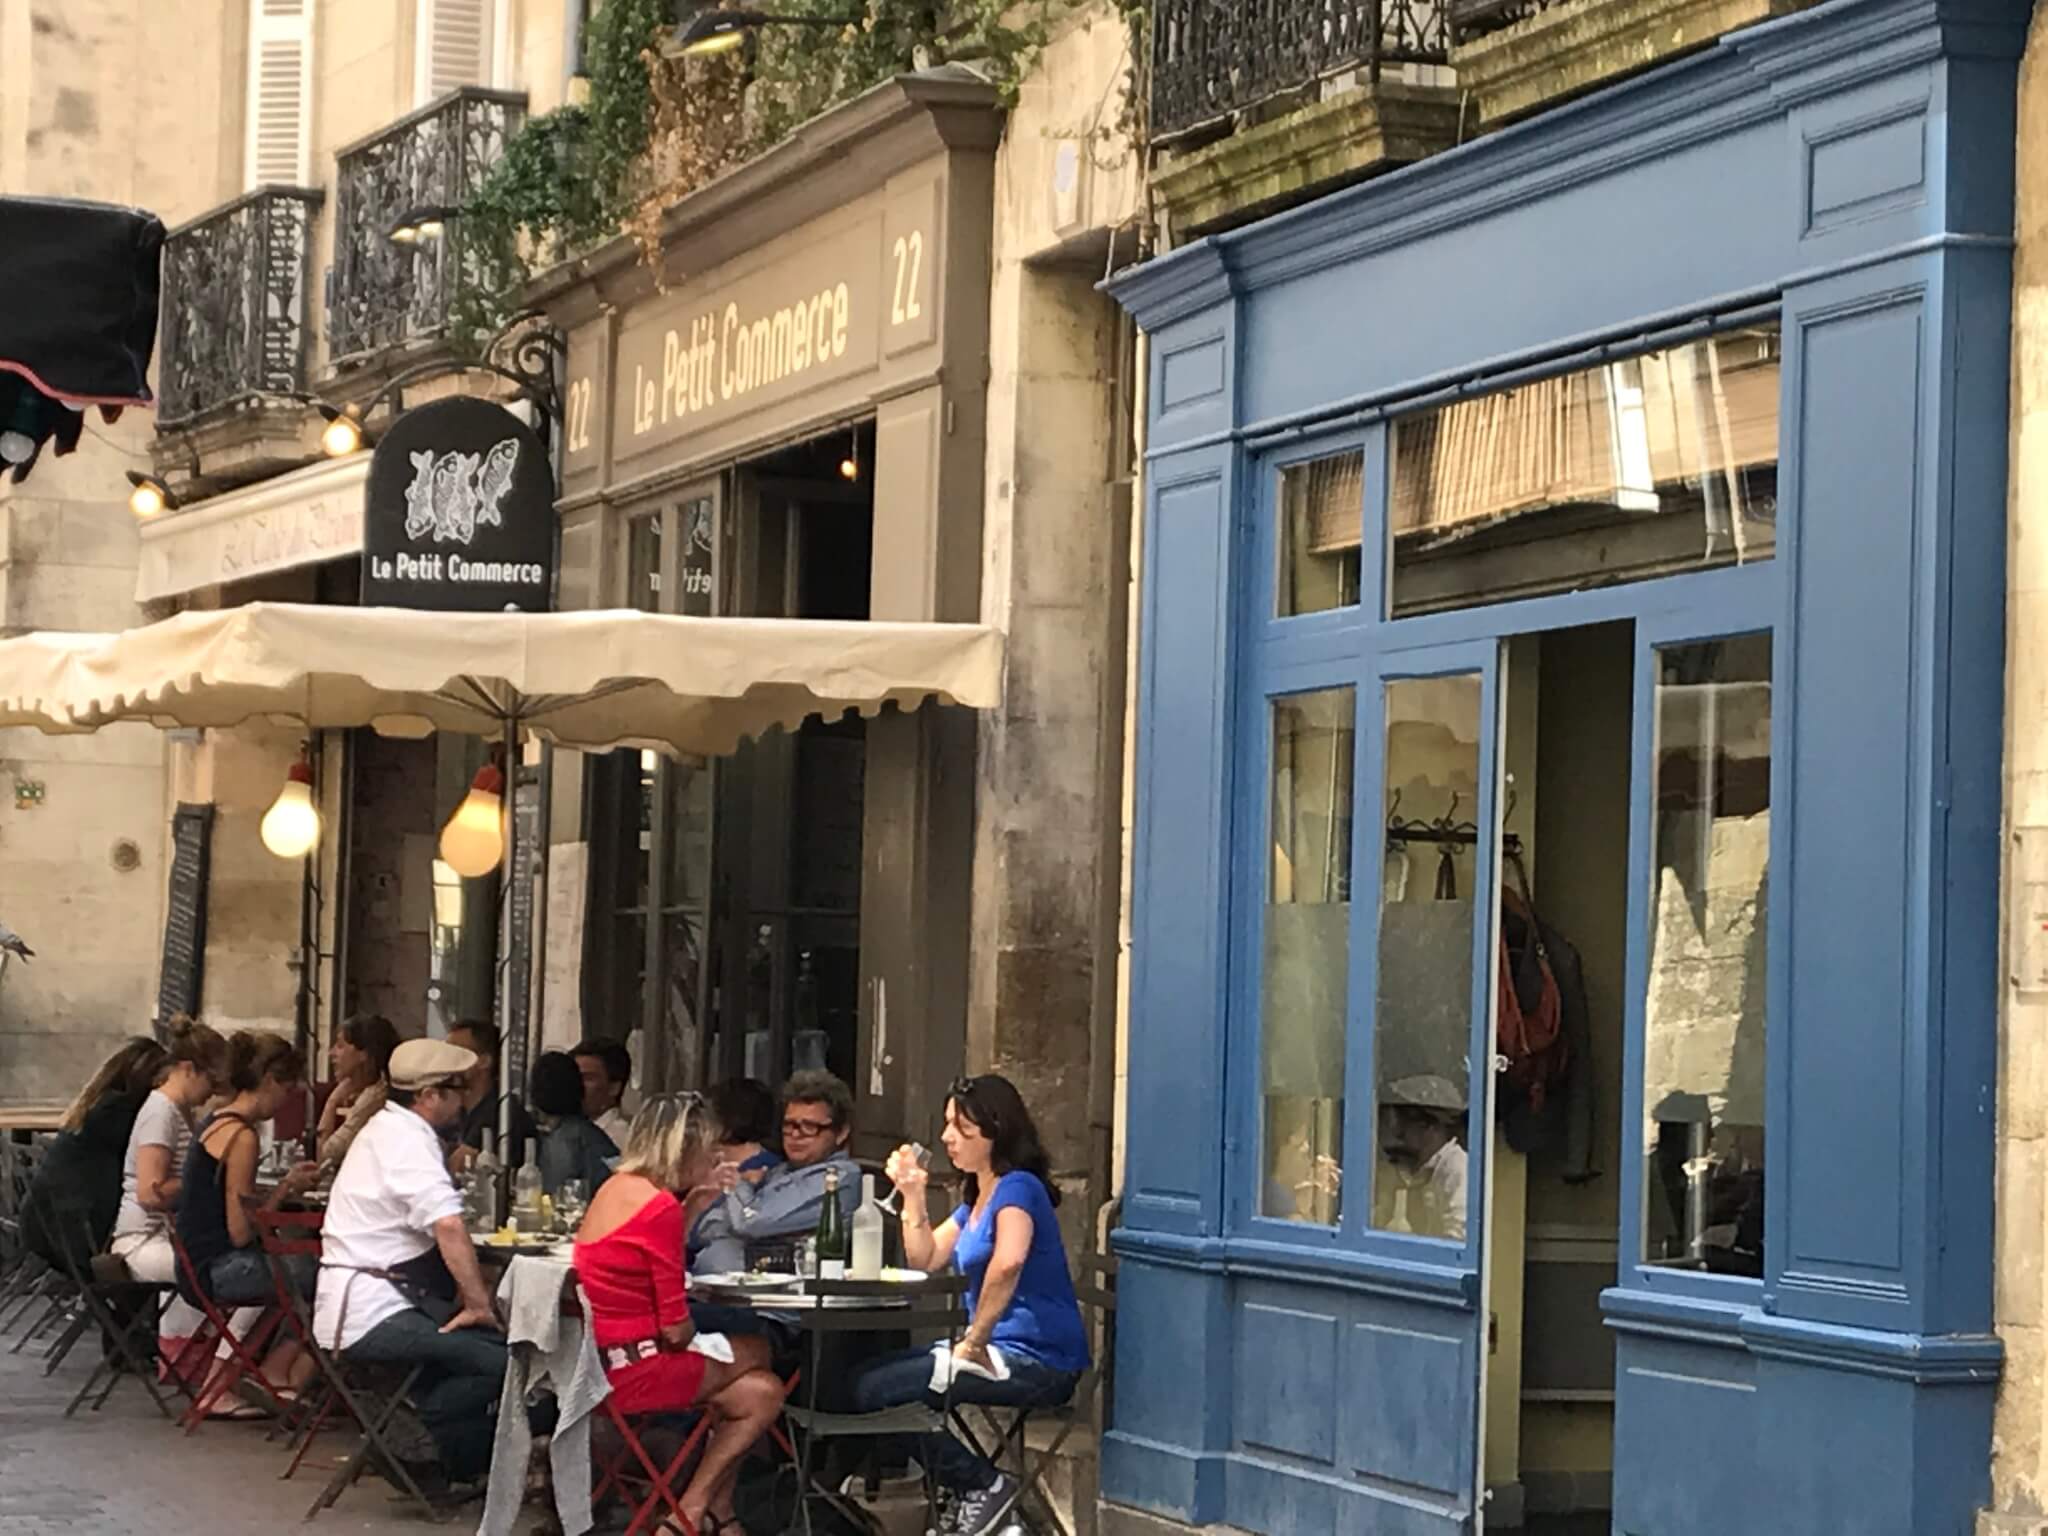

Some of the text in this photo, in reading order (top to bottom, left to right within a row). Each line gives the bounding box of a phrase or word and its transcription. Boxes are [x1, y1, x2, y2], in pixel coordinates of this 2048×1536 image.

[891, 230, 922, 325] 22
[633, 281, 849, 435] Le Petit Commerce
[568, 377, 590, 452] 22
[372, 551, 542, 583] Le Petit Commerce
